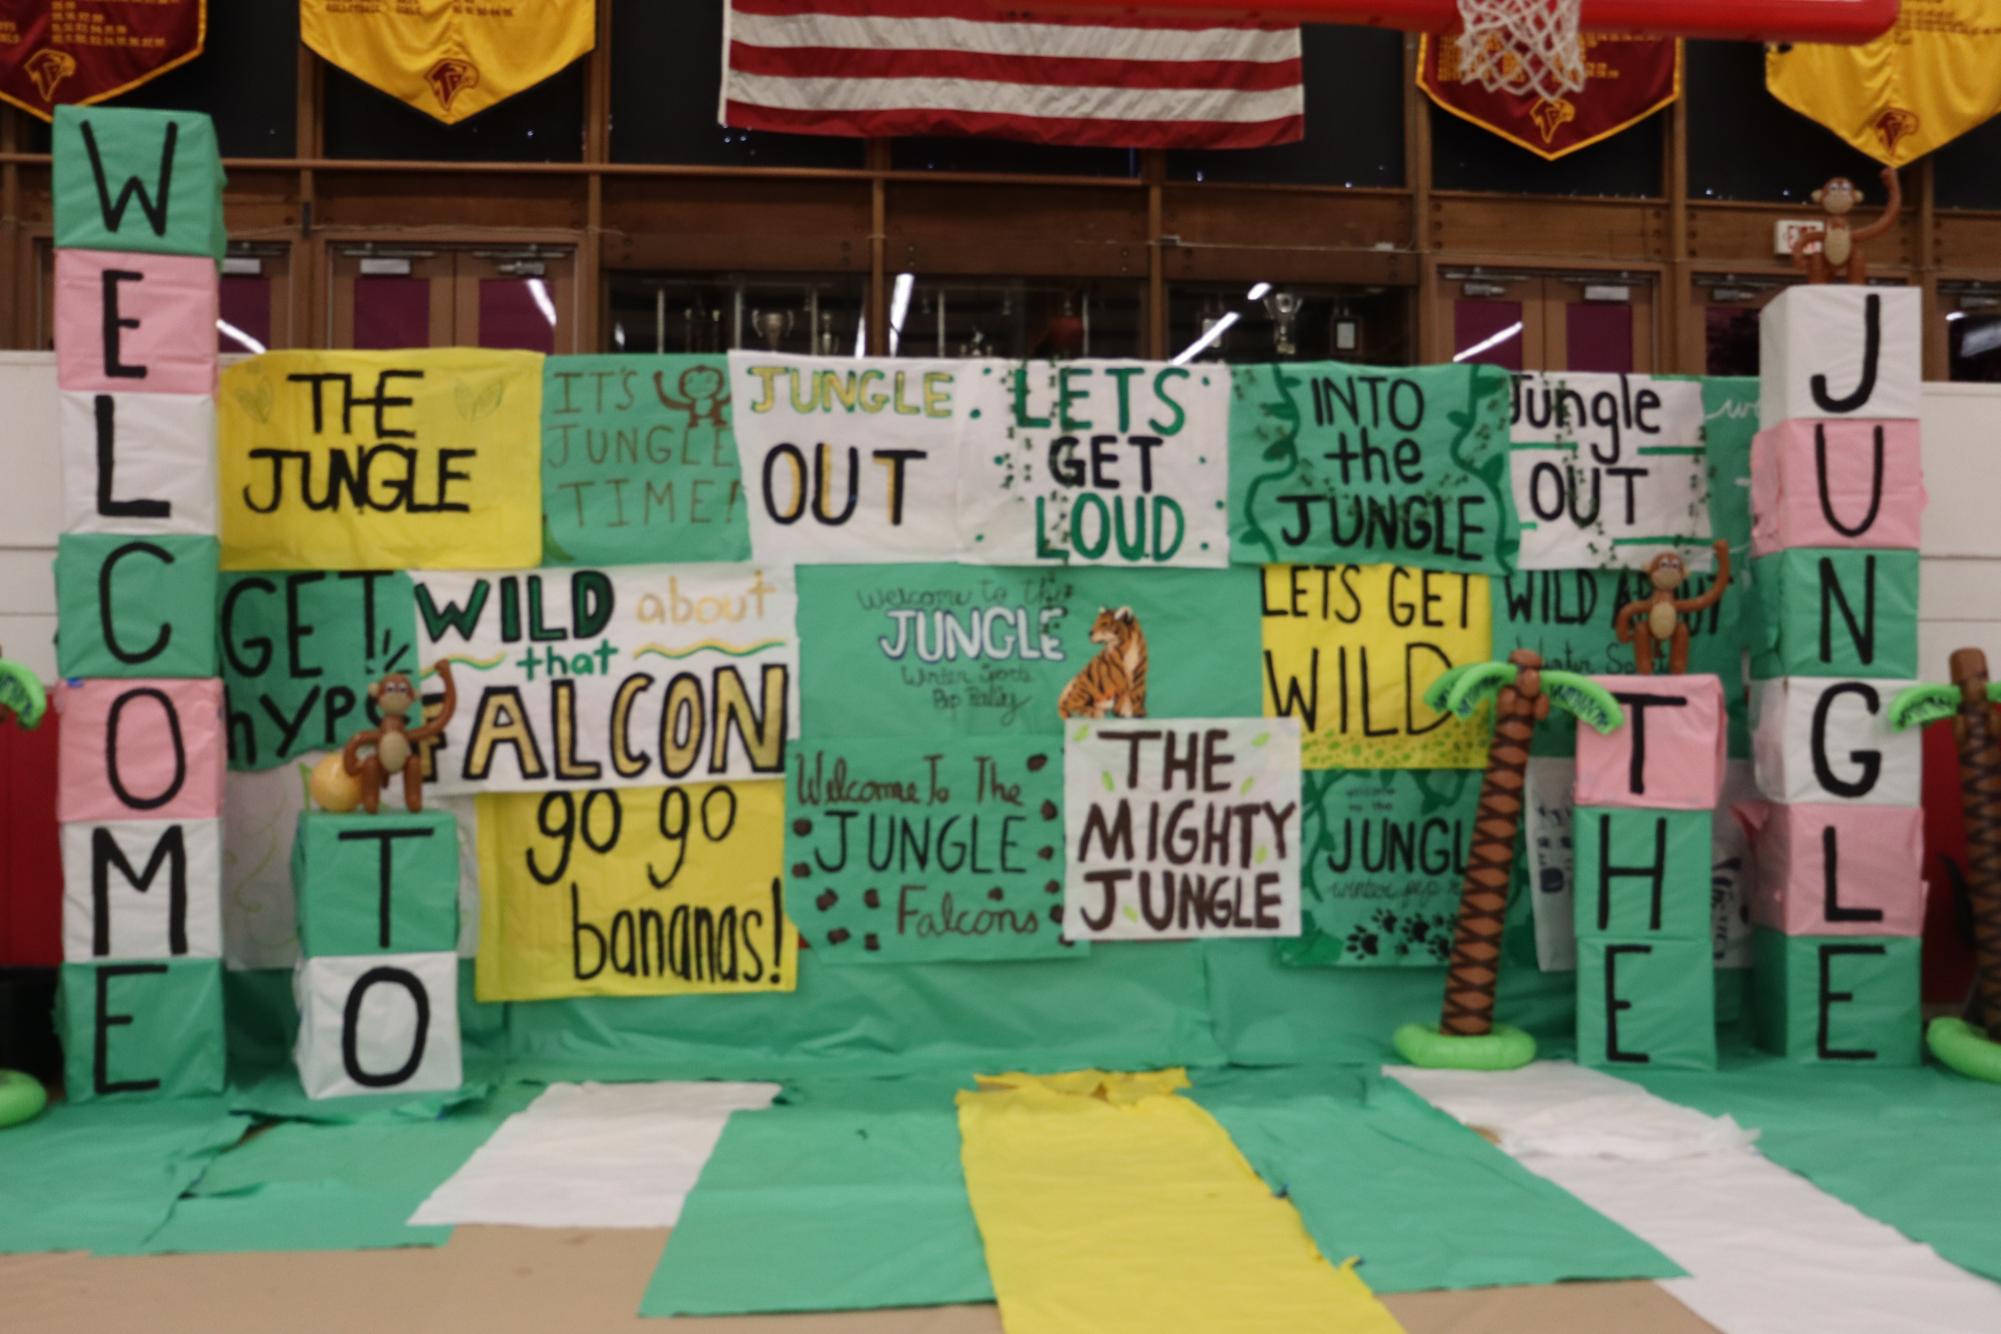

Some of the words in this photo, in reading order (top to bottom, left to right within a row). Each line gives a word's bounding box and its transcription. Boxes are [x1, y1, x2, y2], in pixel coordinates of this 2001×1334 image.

[286, 370, 424, 438] THE
[747, 366, 954, 418] JUNGLE
[1014, 367, 1191, 436] LETS
[1311, 376, 1425, 432] INTO
[1511, 374, 1661, 465] Jungle
[243, 444, 477, 514] JUNGLE
[546, 423, 735, 469] JUNGLE
[1048, 435, 1164, 493] GET
[1323, 428, 1422, 486] the
[557, 478, 742, 528] TIME!
[762, 443, 928, 526] OUT
[1529, 461, 1649, 529] OUT
[1036, 493, 1186, 562] LOUD
[1275, 494, 1486, 562] JUNGLE
[79, 120, 187, 1096] WELCOME
[221, 572, 395, 678] GET
[413, 570, 615, 643] WILD
[636, 569, 777, 626] about
[1261, 564, 1361, 624] LETS
[1388, 566, 1468, 629] GET
[1504, 569, 1598, 625] WILD
[515, 641, 618, 681] that
[879, 604, 1067, 663] JUNGLE
[1264, 642, 1454, 738] WILD
[1809, 293, 1887, 1060] JUNGLE
[410, 663, 788, 781] FALCON
[795, 750, 920, 807] Welcome
[974, 755, 1024, 806] The
[1097, 730, 1235, 792] THE
[526, 789, 622, 885] go
[647, 784, 737, 889] go
[814, 810, 1027, 874] JUNGLE
[1077, 801, 1296, 868] MIGHTY
[1327, 817, 1466, 876] JUNGL
[897, 884, 1039, 938] Falcons
[1080, 869, 1281, 931] JUNGLE
[1597, 691, 1688, 1063] THE
[337, 827, 434, 1089] TO
[571, 877, 782, 984] bananas!
